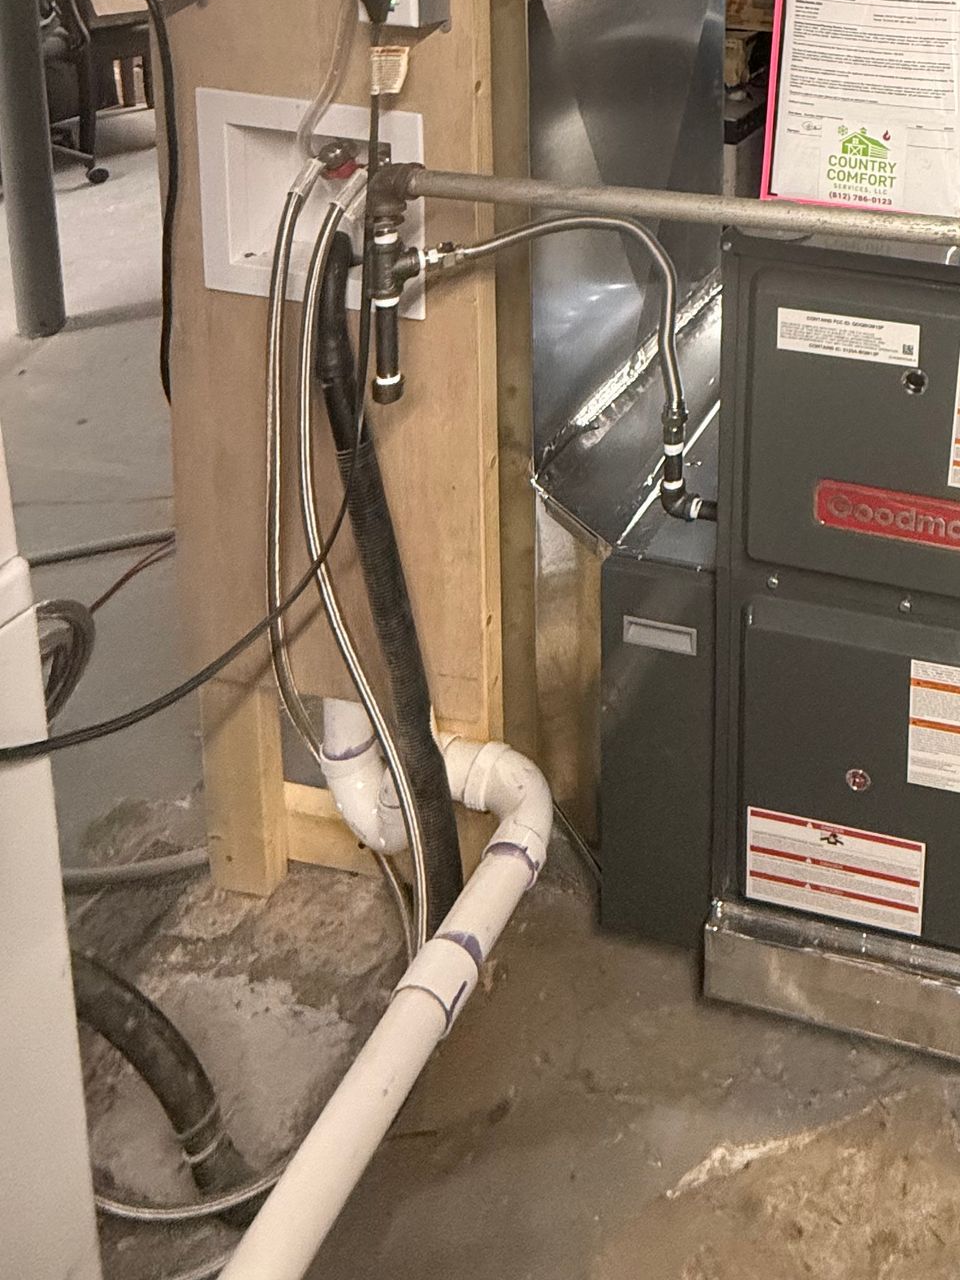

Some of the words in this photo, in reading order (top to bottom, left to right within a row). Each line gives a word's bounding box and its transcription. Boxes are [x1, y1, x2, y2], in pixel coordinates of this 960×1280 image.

[828, 155, 897, 174] COUNTRY
[827, 169, 897, 189] COMFORT
[829, 191, 851, 200] (812)
[853, 194, 892, 205] 786-0123
